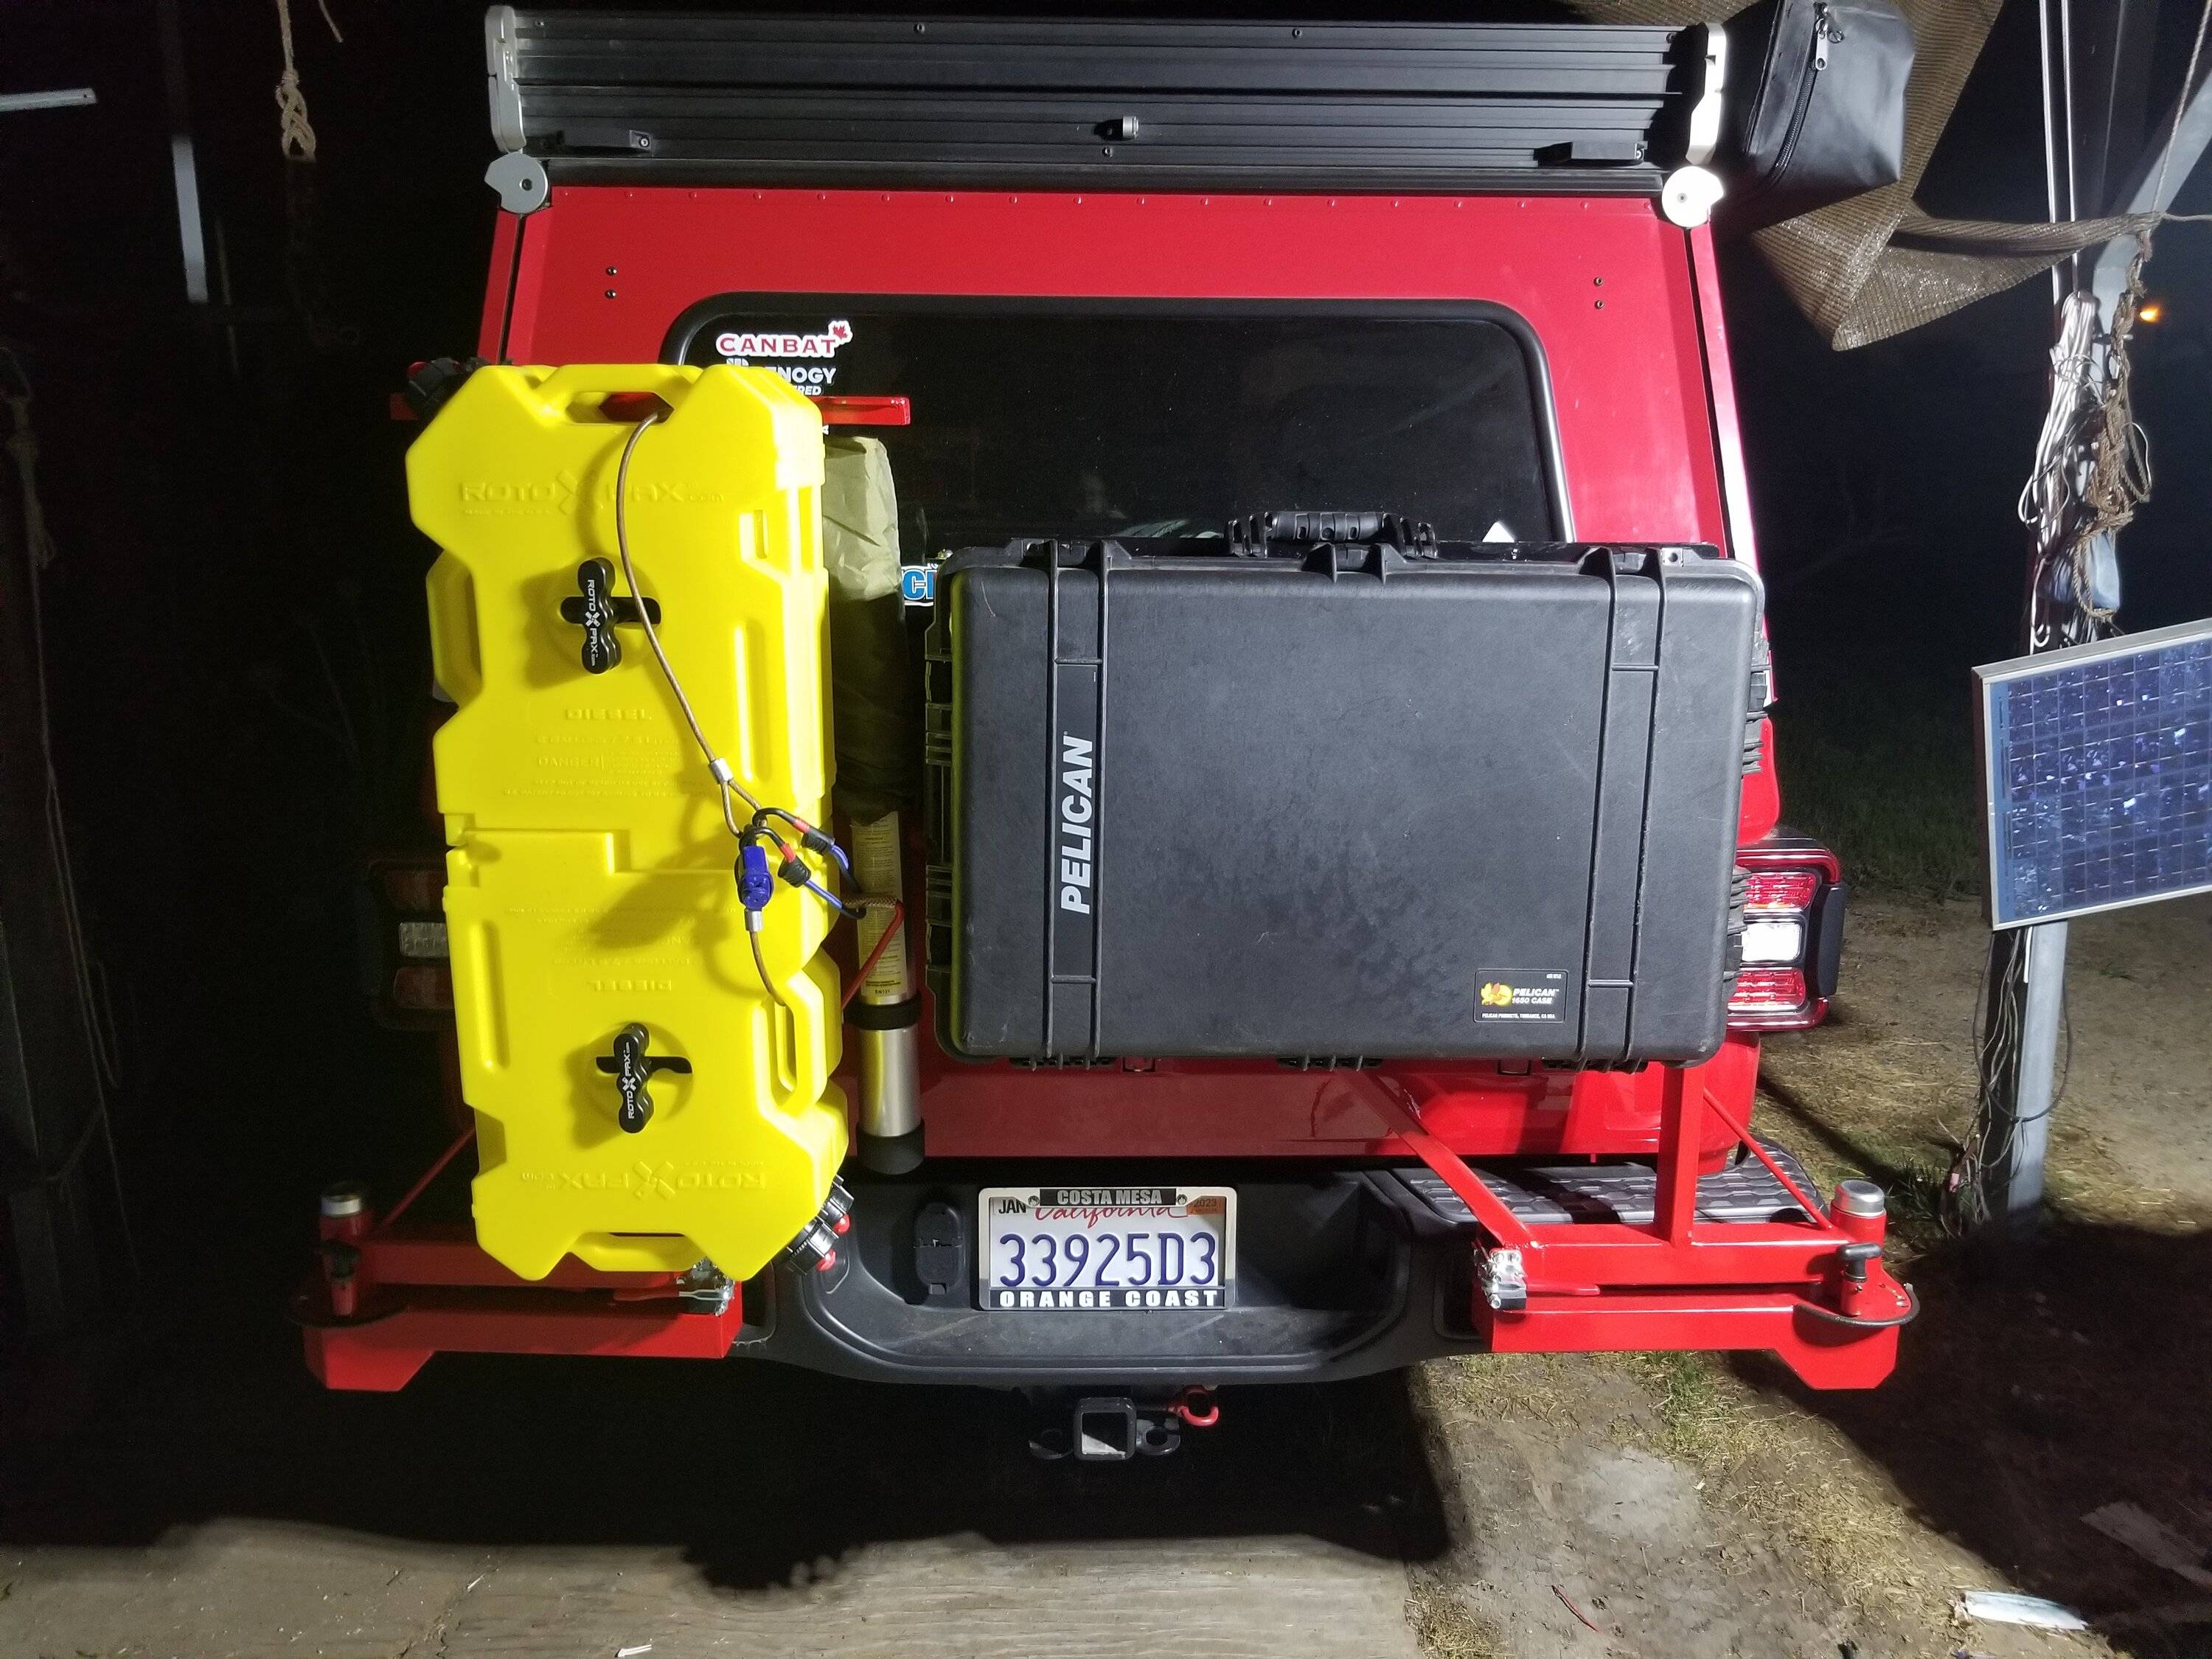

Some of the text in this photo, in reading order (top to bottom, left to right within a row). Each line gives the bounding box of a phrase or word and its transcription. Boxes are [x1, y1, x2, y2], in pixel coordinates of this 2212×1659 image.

[719, 337, 836, 354] CANBAT
[587, 579, 597, 612] ROTO
[565, 708, 653, 720] DIESEL
[1060, 734, 1093, 915] PELICAN
[1512, 988, 1556, 997] PELICAN
[626, 1090, 635, 1119] ROTO
[1057, 1189, 1163, 1205] COSTA MESA
[998, 1199, 1026, 1214] JAN
[999, 1231, 1217, 1287] 33925D3
[999, 1290, 1217, 1307] ORANGE COAST
